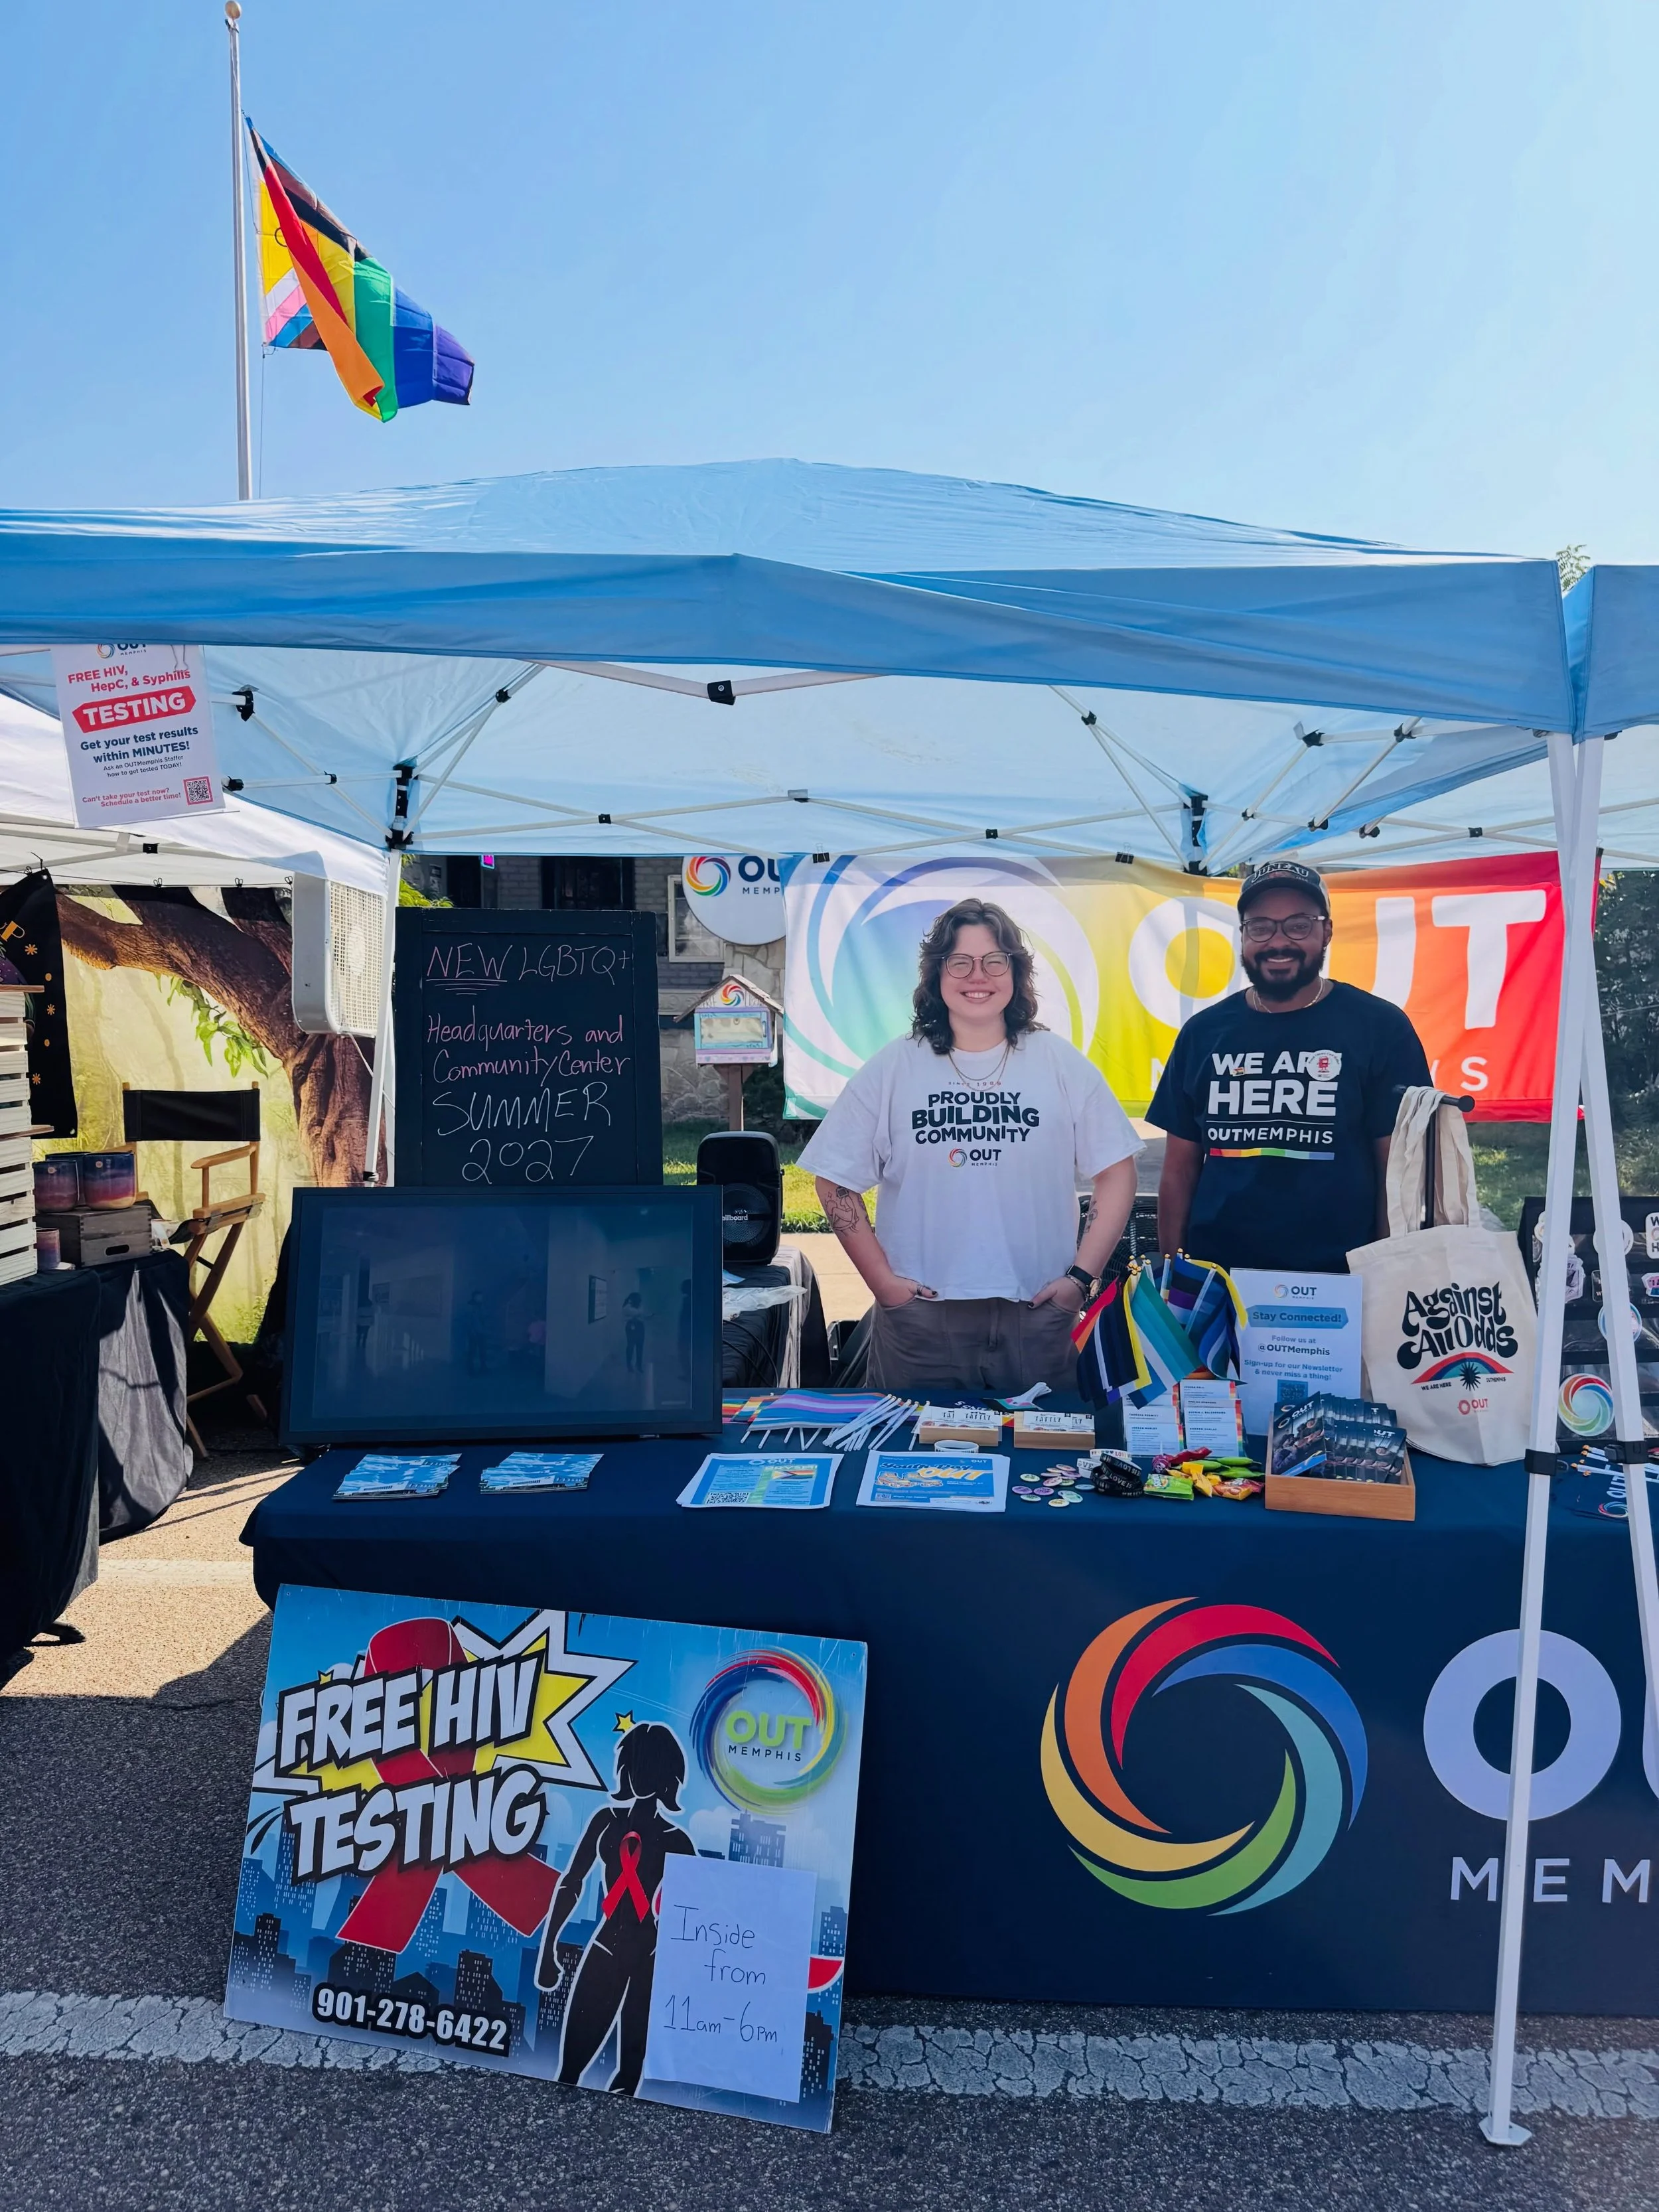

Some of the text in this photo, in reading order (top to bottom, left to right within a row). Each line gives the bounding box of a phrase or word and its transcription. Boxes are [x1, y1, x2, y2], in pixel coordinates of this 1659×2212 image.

[68, 664, 128, 684] FREE HIV,
[91, 670, 191, 692] HepC, & Syphilis
[83, 692, 186, 726] TESTING
[80, 726, 198, 751] Get your test results
[93, 741, 190, 763] within MINUTES!
[124, 757, 163, 768] OUTMemphis
[160, 762, 182, 771] TODAY!
[101, 798, 133, 807] Schedule
[1251, 862, 1309, 883] JUNEAU
[427, 943, 631, 985] NEW LGBTQ+
[427, 1005, 623, 1051] Headquarters and
[1212, 1052, 1265, 1076] WE
[432, 1081, 611, 1136] SUMMER
[928, 1091, 1021, 1108] PROUDLY
[1208, 1079, 1338, 1116] HERE
[912, 1104, 1040, 1130] BUILDING
[915, 1126, 1031, 1144] COMMUNITY
[1208, 1128, 1333, 1144] OUTMEMPHIS
[462, 1135, 595, 1185] 2027
[970, 1149, 1002, 1161] OUT
[1291, 1286, 1317, 1296] OUT
[1252, 1311, 1342, 1323] Stay Connected!
[1402, 1281, 1506, 1337] Against
[1258, 1343, 1331, 1356] @OUTMemphis
[1397, 1315, 1518, 1370] All Odds
[1244, 1359, 1273, 1368] Sign-up
[1302, 1364, 1342, 1373] Newsletter
[1309, 1372, 1332, 1382] thing!
[1291, 1400, 1315, 1418] OUT
[1471, 1398, 1488, 1409] OUT
[918, 1467, 989, 1481] OUT
[281, 1658, 540, 1769] FREE HIV
[726, 1710, 812, 1747] OUT
[728, 1744, 803, 1763] MEMPHIS
[287, 1767, 545, 1882] TESTING
[671, 1905, 756, 1949] Inside
[705, 1949, 766, 1986] from
[317, 1988, 508, 2052] 901-278-6422
